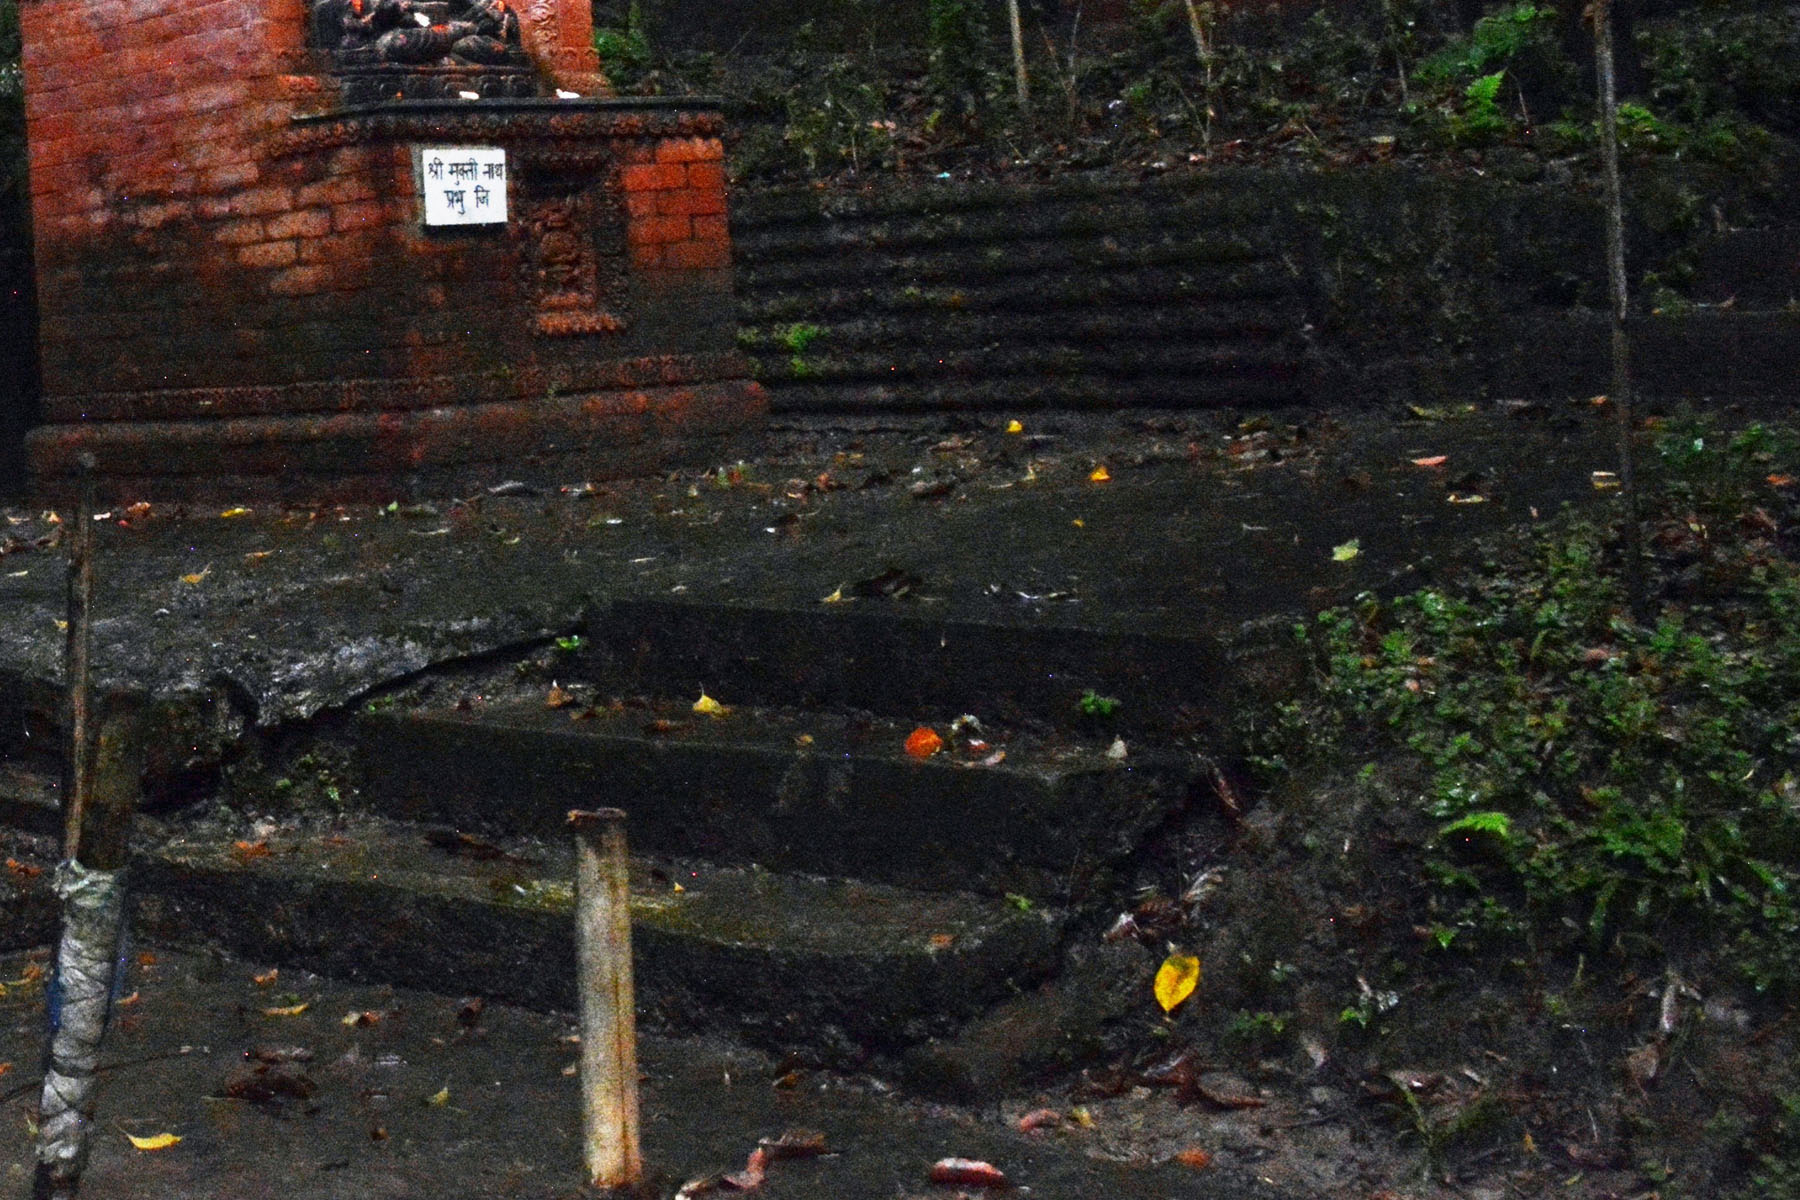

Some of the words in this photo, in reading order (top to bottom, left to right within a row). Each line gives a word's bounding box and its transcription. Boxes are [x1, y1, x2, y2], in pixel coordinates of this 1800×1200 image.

[428, 157, 444, 180] श्री
[482, 162, 504, 180] नाथ
[473, 184, 491, 209] जि
